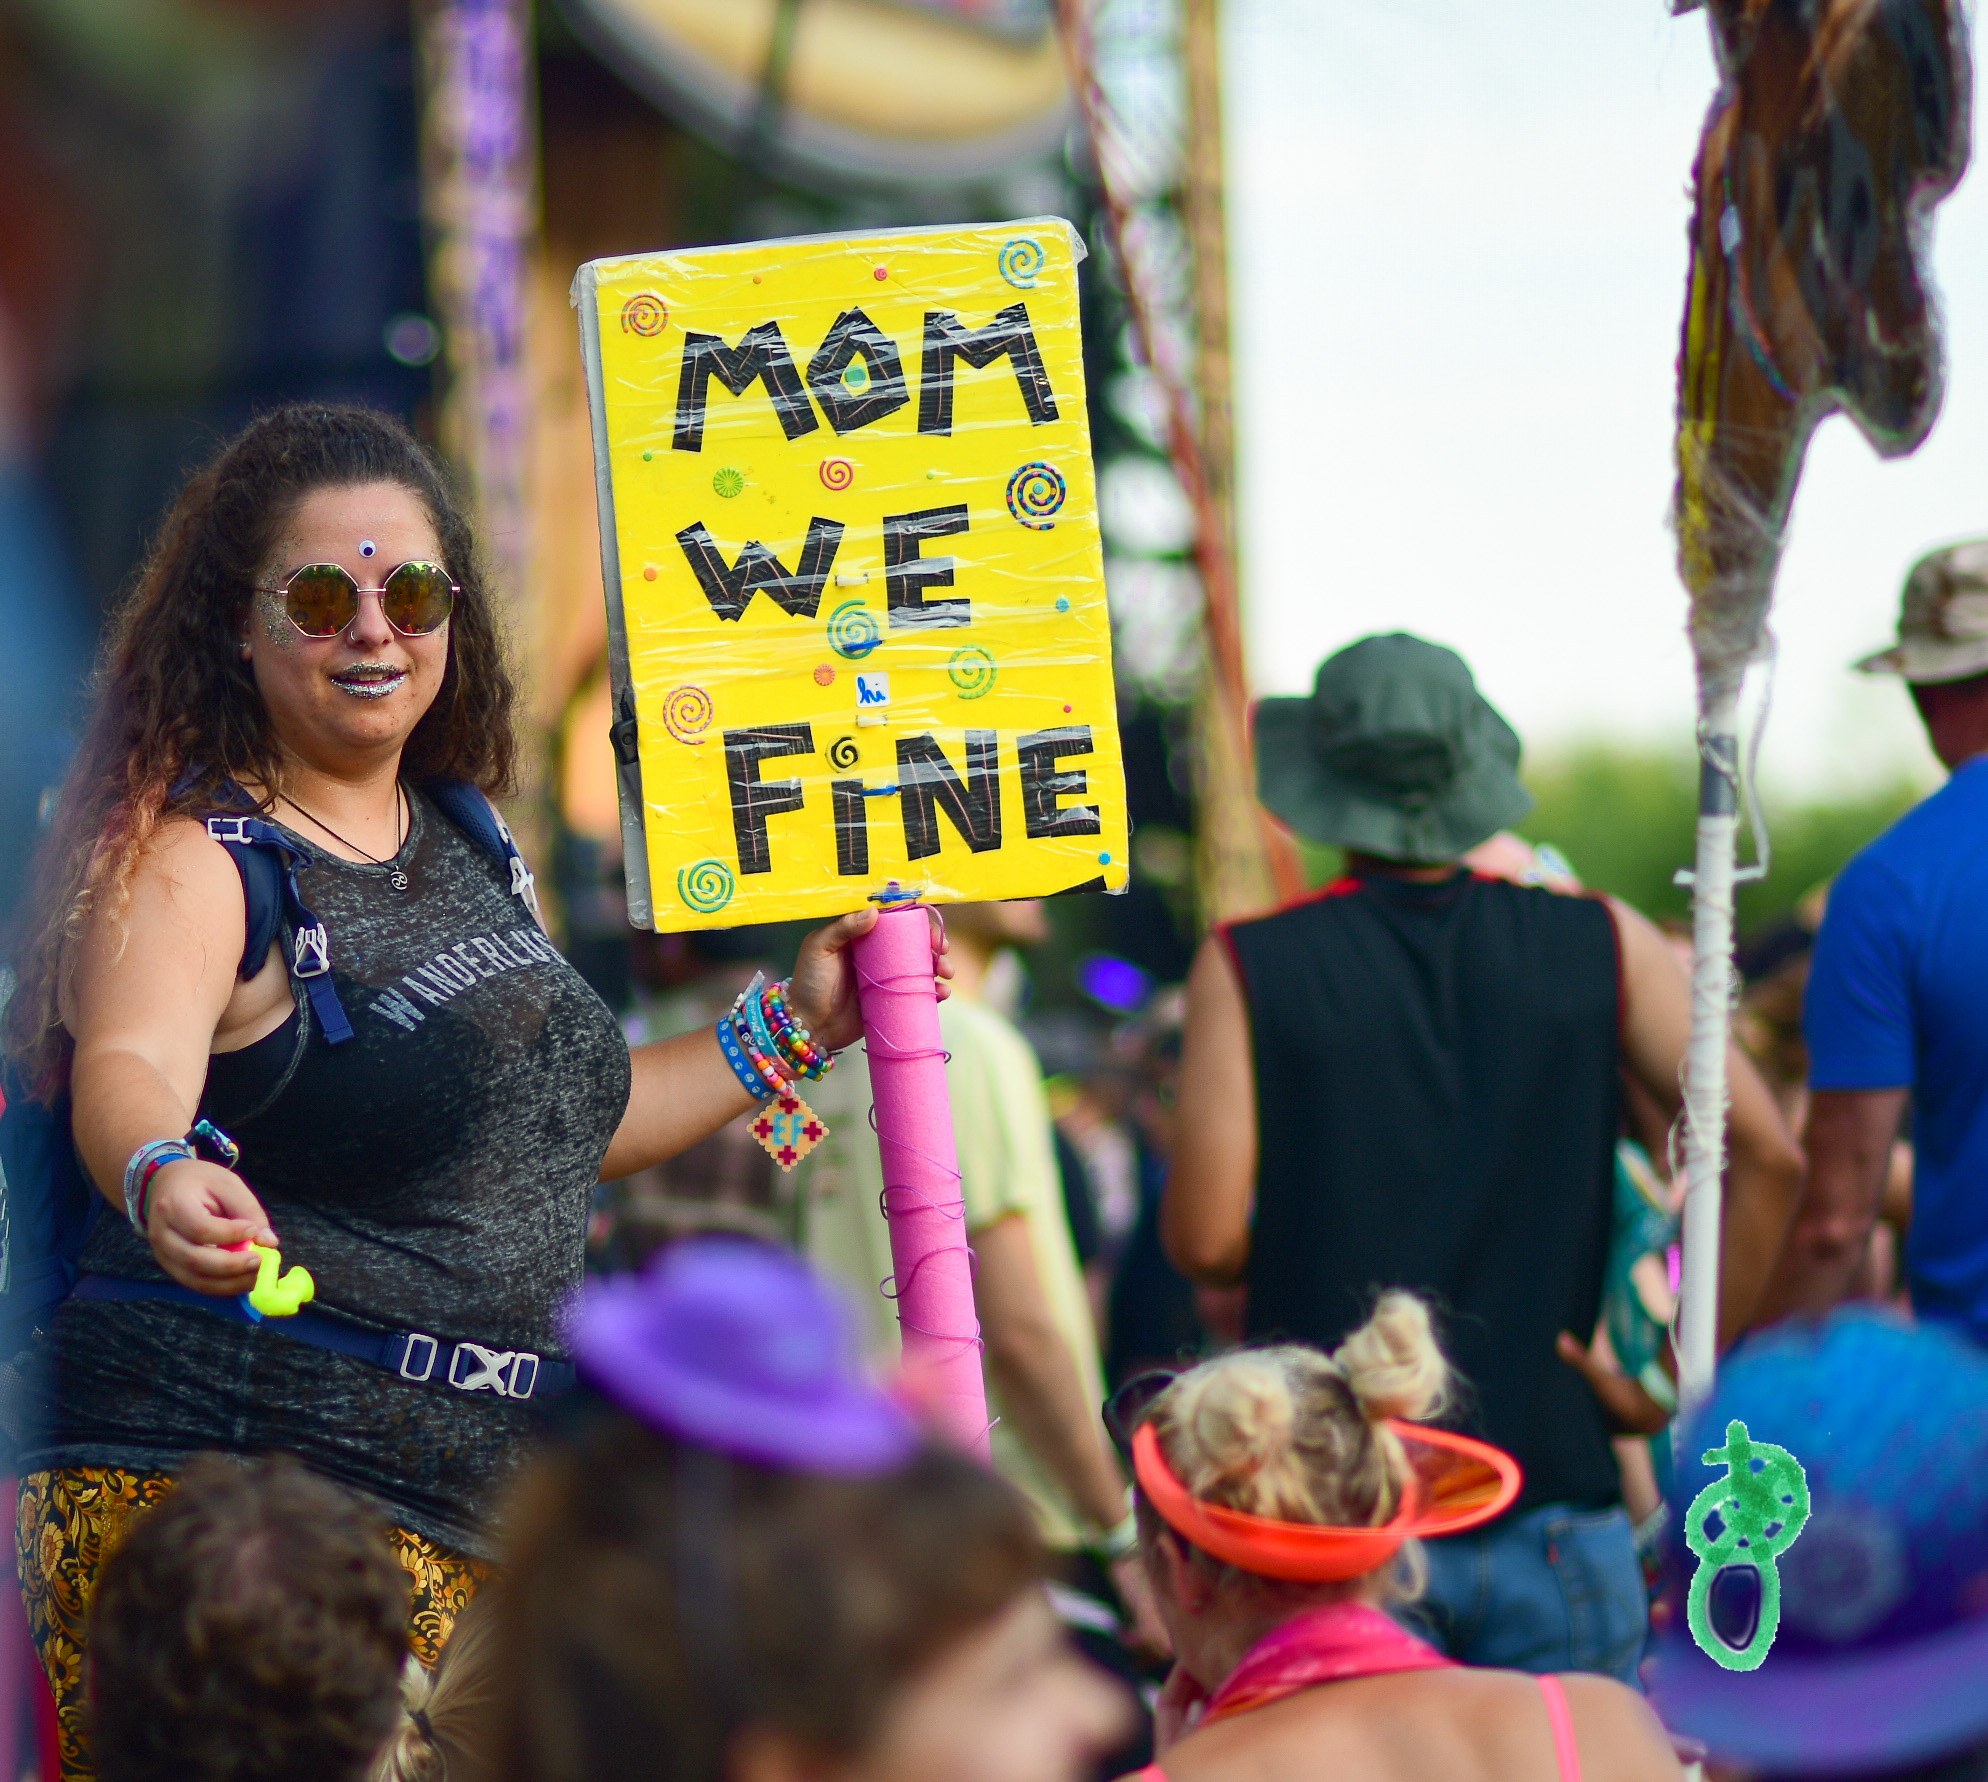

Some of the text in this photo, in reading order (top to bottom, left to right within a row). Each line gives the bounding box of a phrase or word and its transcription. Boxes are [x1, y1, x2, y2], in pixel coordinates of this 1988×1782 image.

[672, 303, 1059, 452] MOM
[675, 503, 972, 629] WE
[857, 676, 886, 704] hi
[772, 1113, 805, 1146] EF
